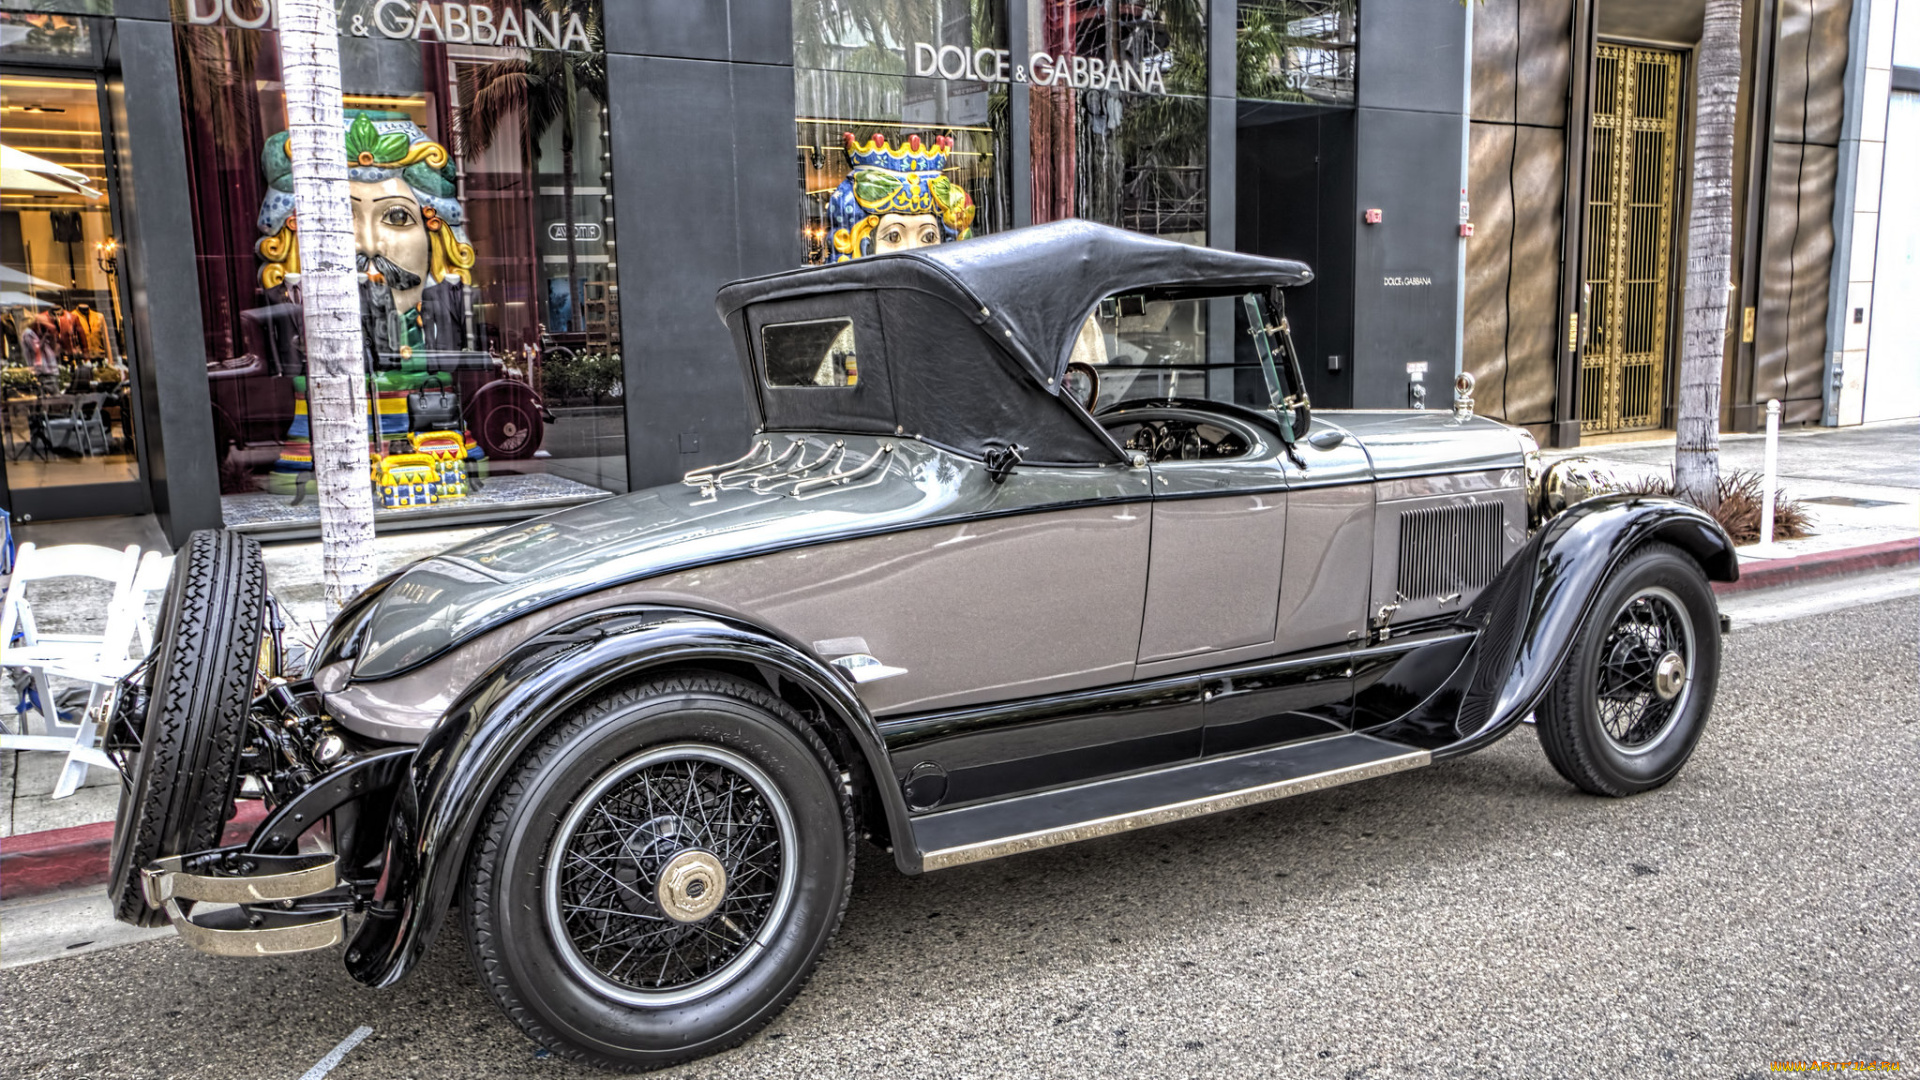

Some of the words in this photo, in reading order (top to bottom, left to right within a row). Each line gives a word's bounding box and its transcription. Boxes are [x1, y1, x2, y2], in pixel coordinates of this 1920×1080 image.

[351, 14, 369, 37] &
[373, 0, 592, 52] GABBANA
[914, 42, 1010, 83] DOLCE
[1015, 65, 1028, 83] &
[1029, 52, 1167, 95] GABBANA
[1285, 71, 1310, 89] 312
